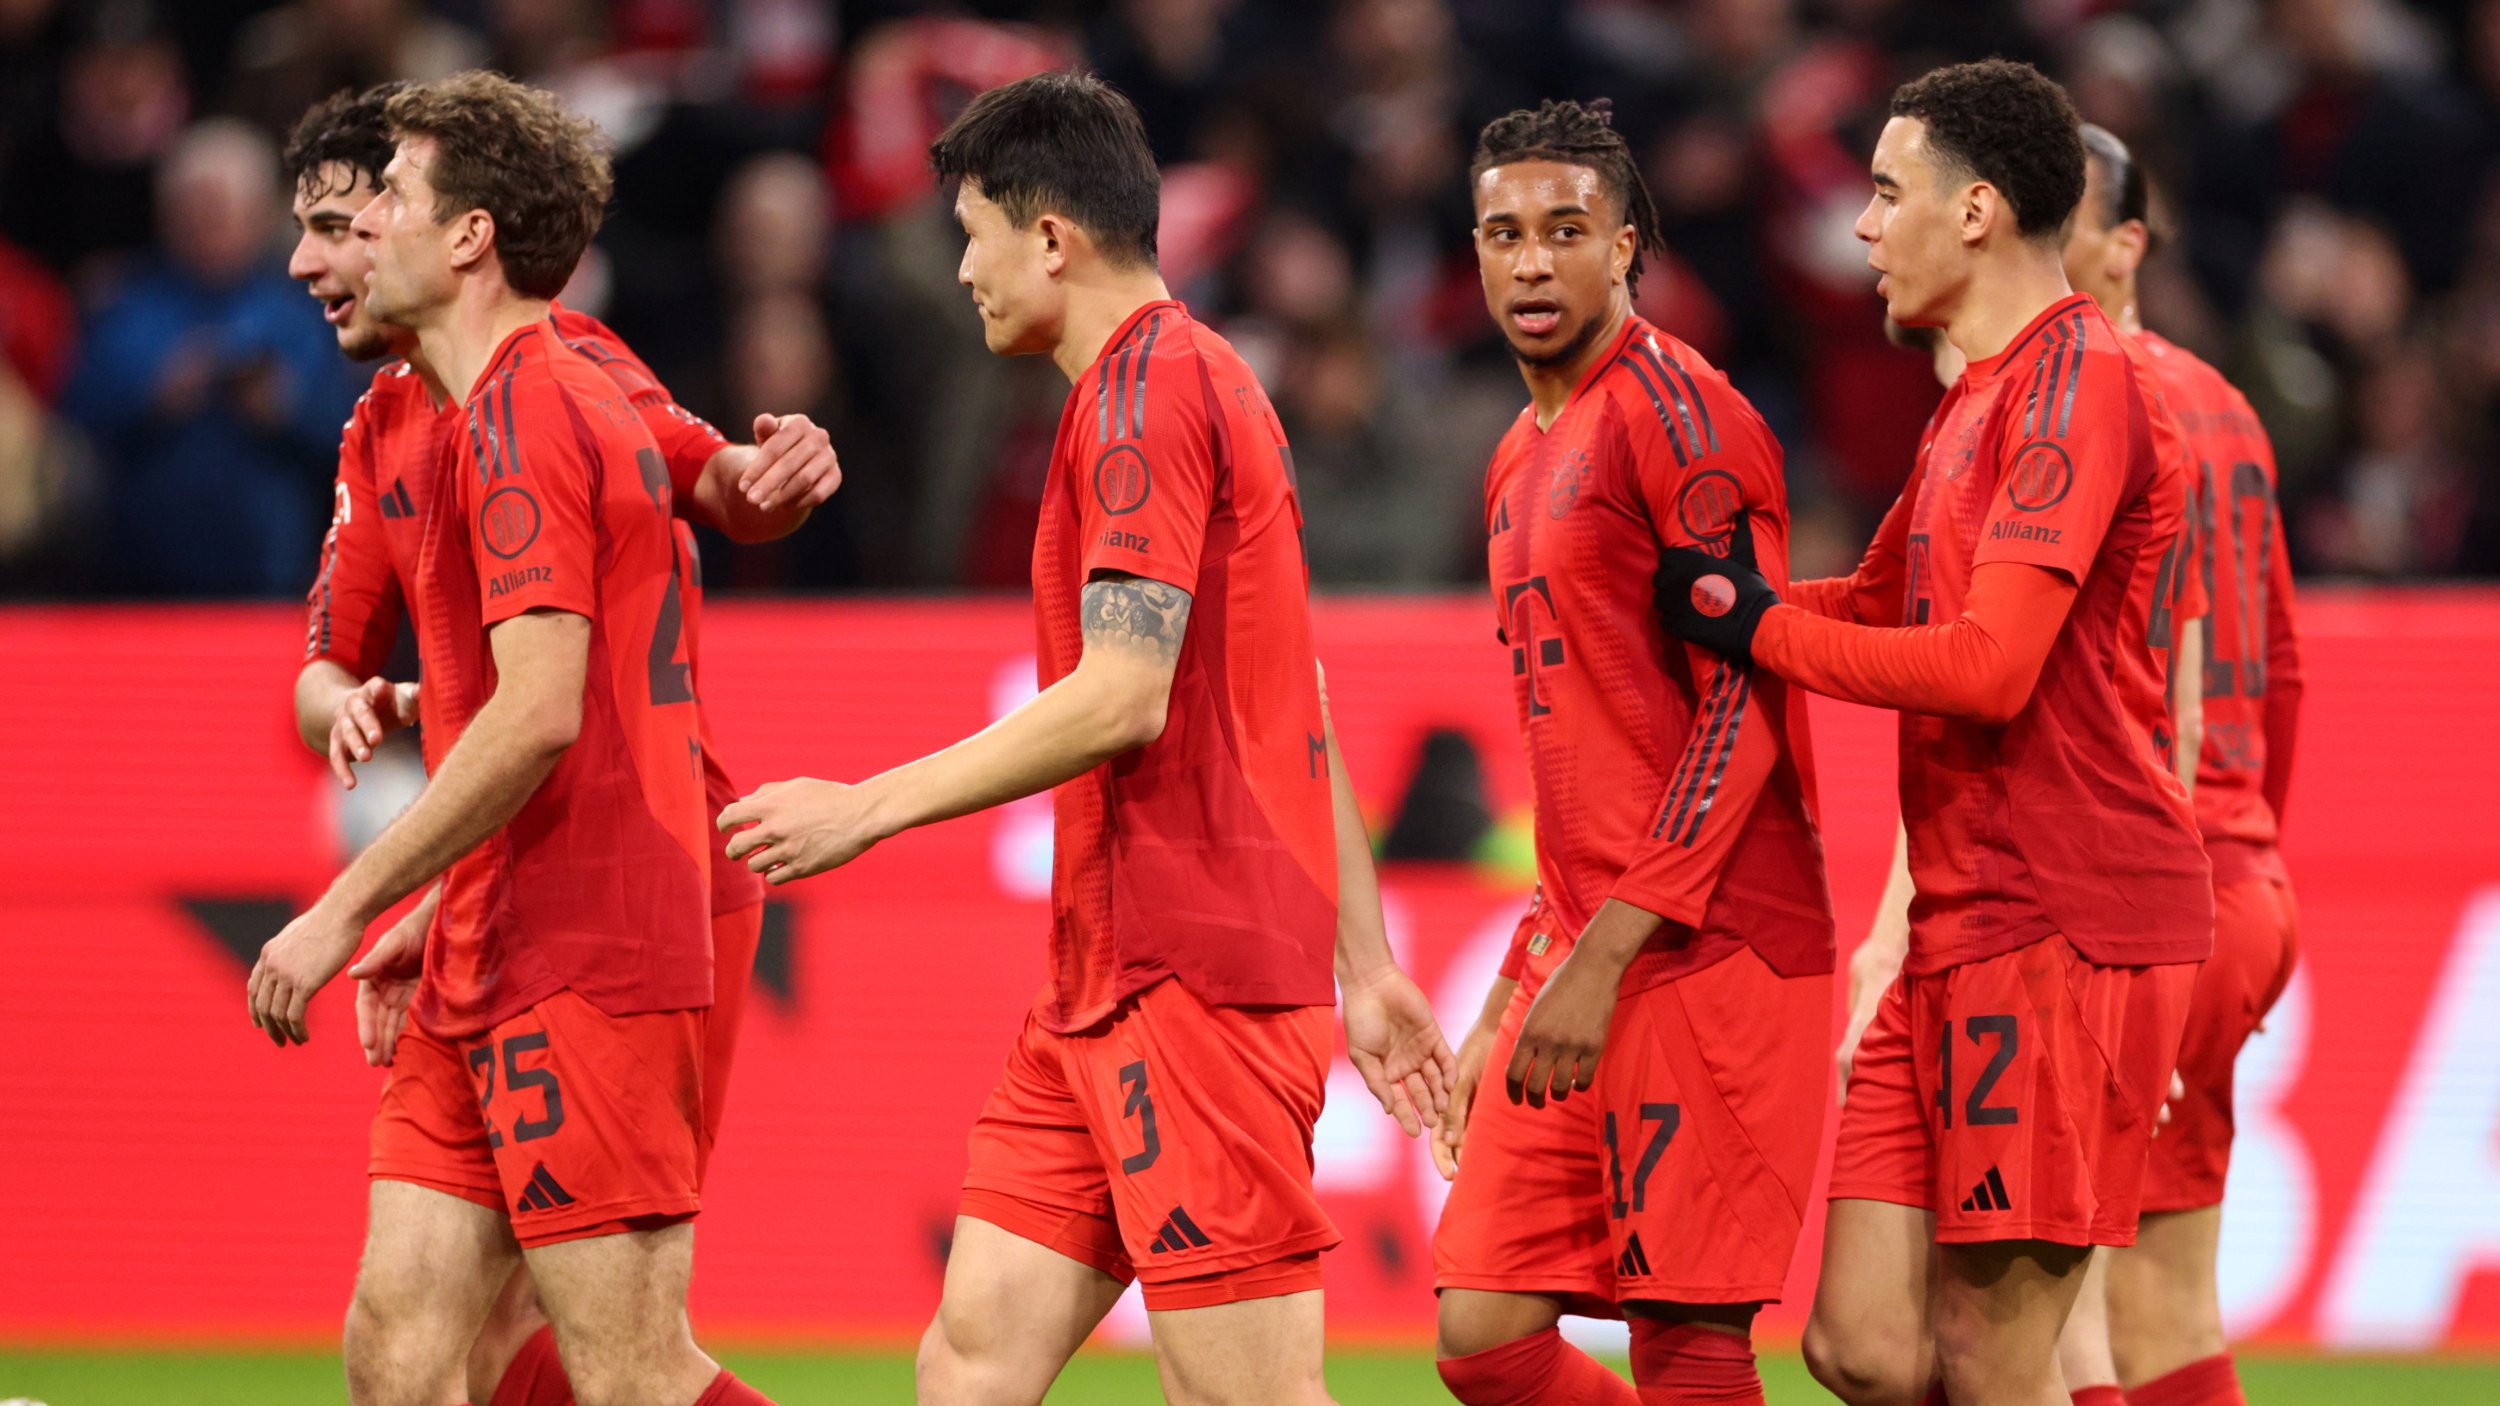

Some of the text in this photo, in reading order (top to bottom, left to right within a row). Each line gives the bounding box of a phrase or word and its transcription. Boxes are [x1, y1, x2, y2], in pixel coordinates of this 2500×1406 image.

[1100, 527, 1150, 554] ianz
[1988, 521, 2062, 544] Allianz
[489, 565, 553, 600] Allianz
[469, 1031, 564, 1149] 25
[1119, 1059, 1161, 1176] 3
[1605, 1103, 1680, 1220] 17
